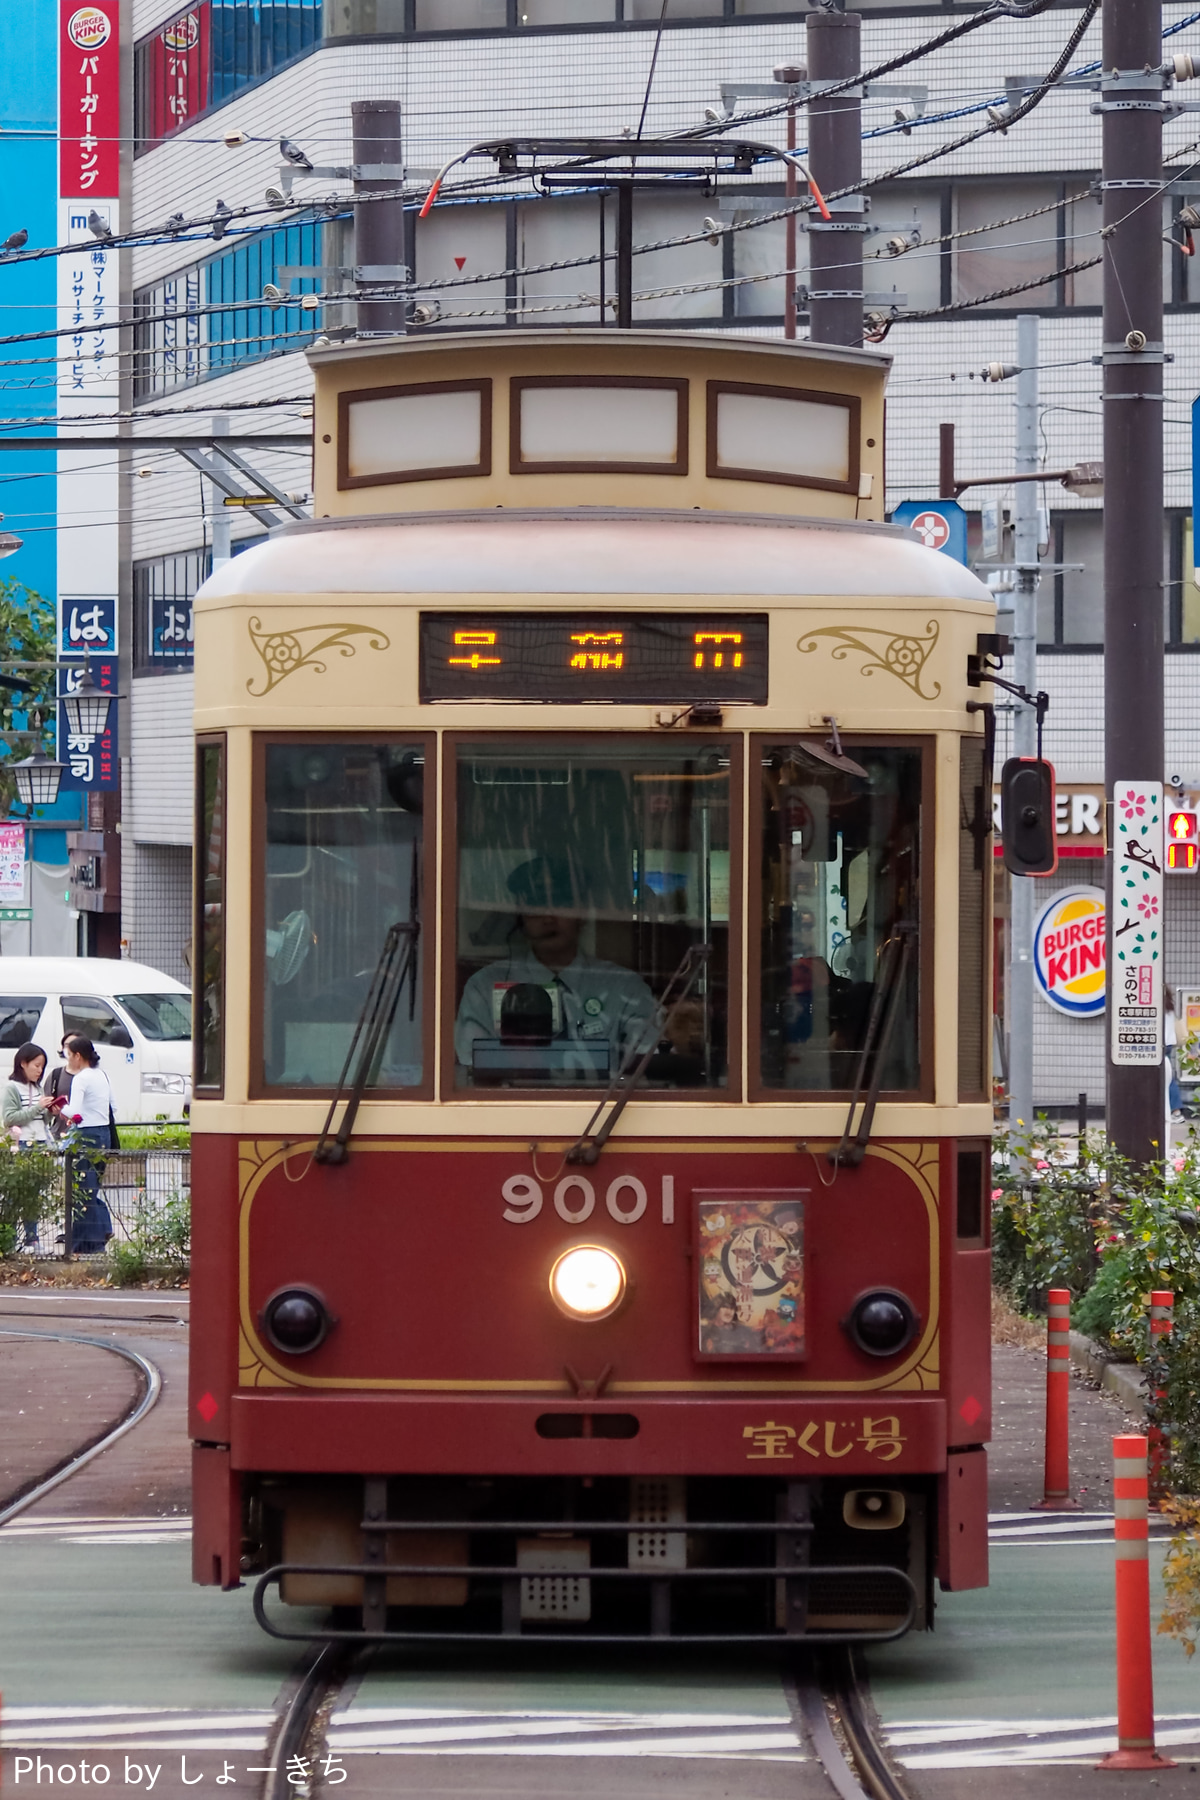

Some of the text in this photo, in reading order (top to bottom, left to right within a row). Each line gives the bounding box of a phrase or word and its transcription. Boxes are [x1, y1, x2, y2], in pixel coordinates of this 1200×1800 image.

[73, 16, 104, 30] BURGER
[75, 23, 105, 40] KING
[79, 56, 100, 190] バーガーキング
[70, 605, 109, 641] は
[1043, 915, 1106, 959] BURGE
[1125, 965, 1138, 1004] さのや
[501, 1174, 675, 1224] 9001
[742, 1415, 908, 1461] 宝くじ号
